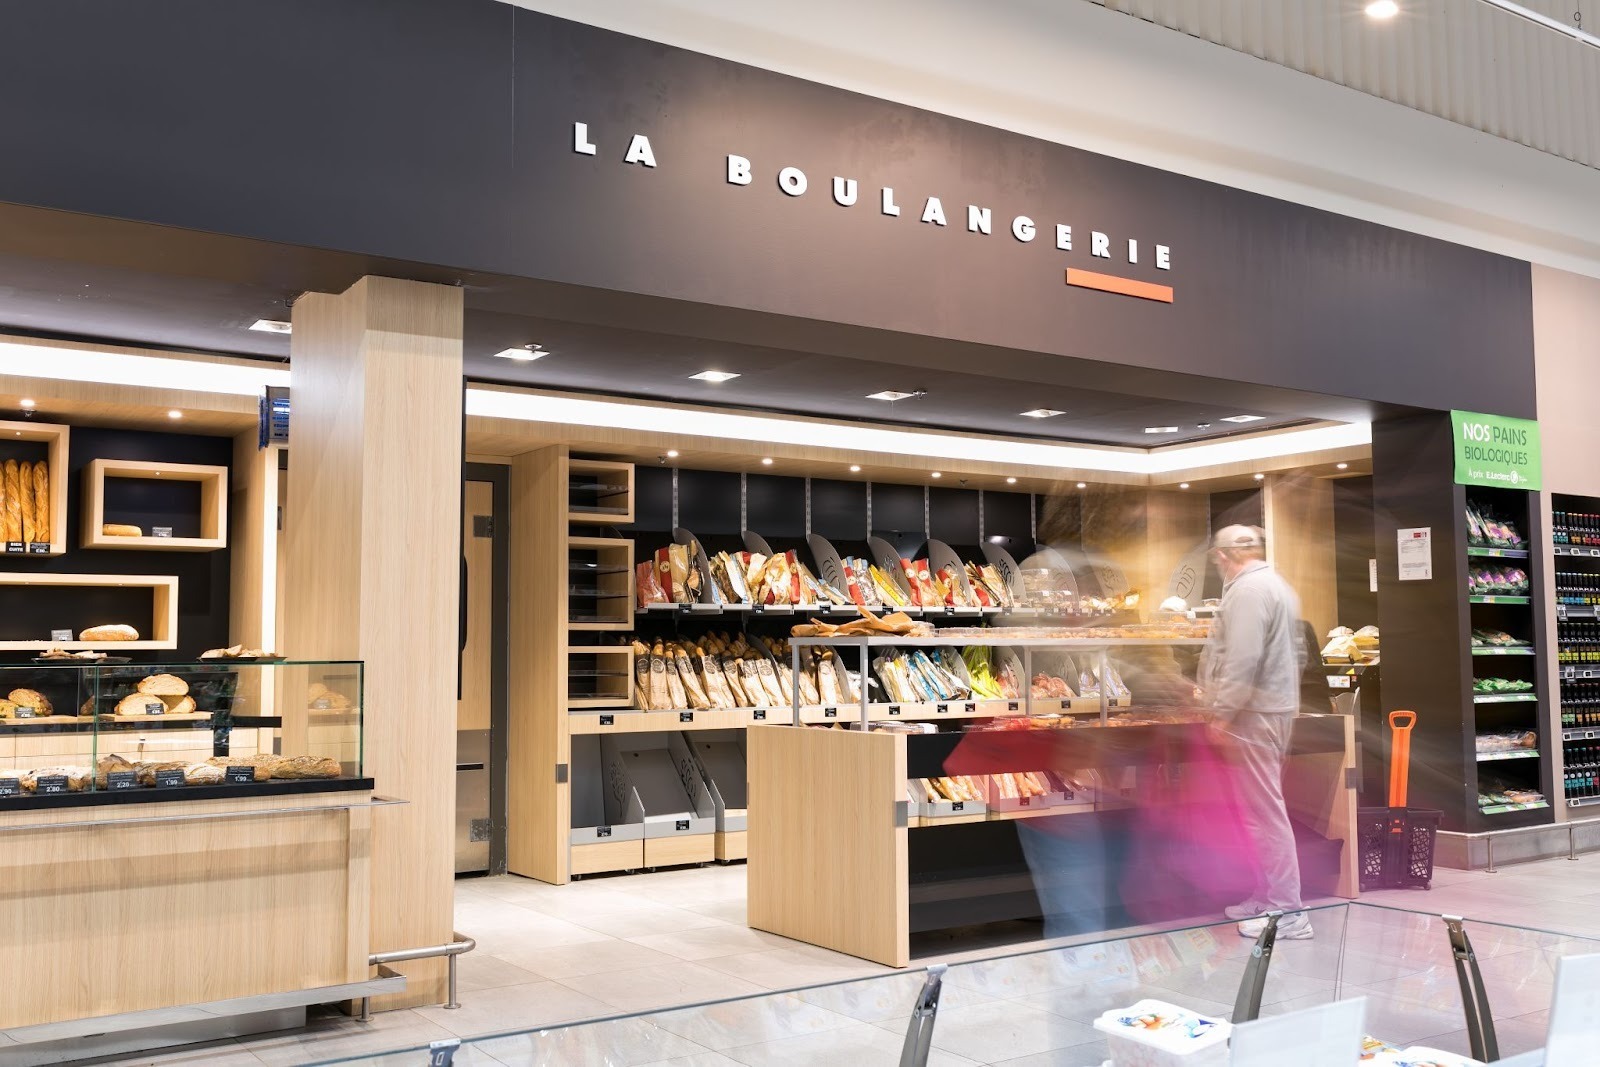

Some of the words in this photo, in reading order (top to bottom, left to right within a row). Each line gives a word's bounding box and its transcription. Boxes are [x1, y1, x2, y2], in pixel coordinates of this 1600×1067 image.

[573, 121, 657, 169] LA
[726, 153, 1171, 271] BOULANGERIE
[1462, 422, 1490, 442] NOS
[1492, 426, 1527, 446] PAINS
[1464, 446, 1528, 466] BIOLOGIQUES
